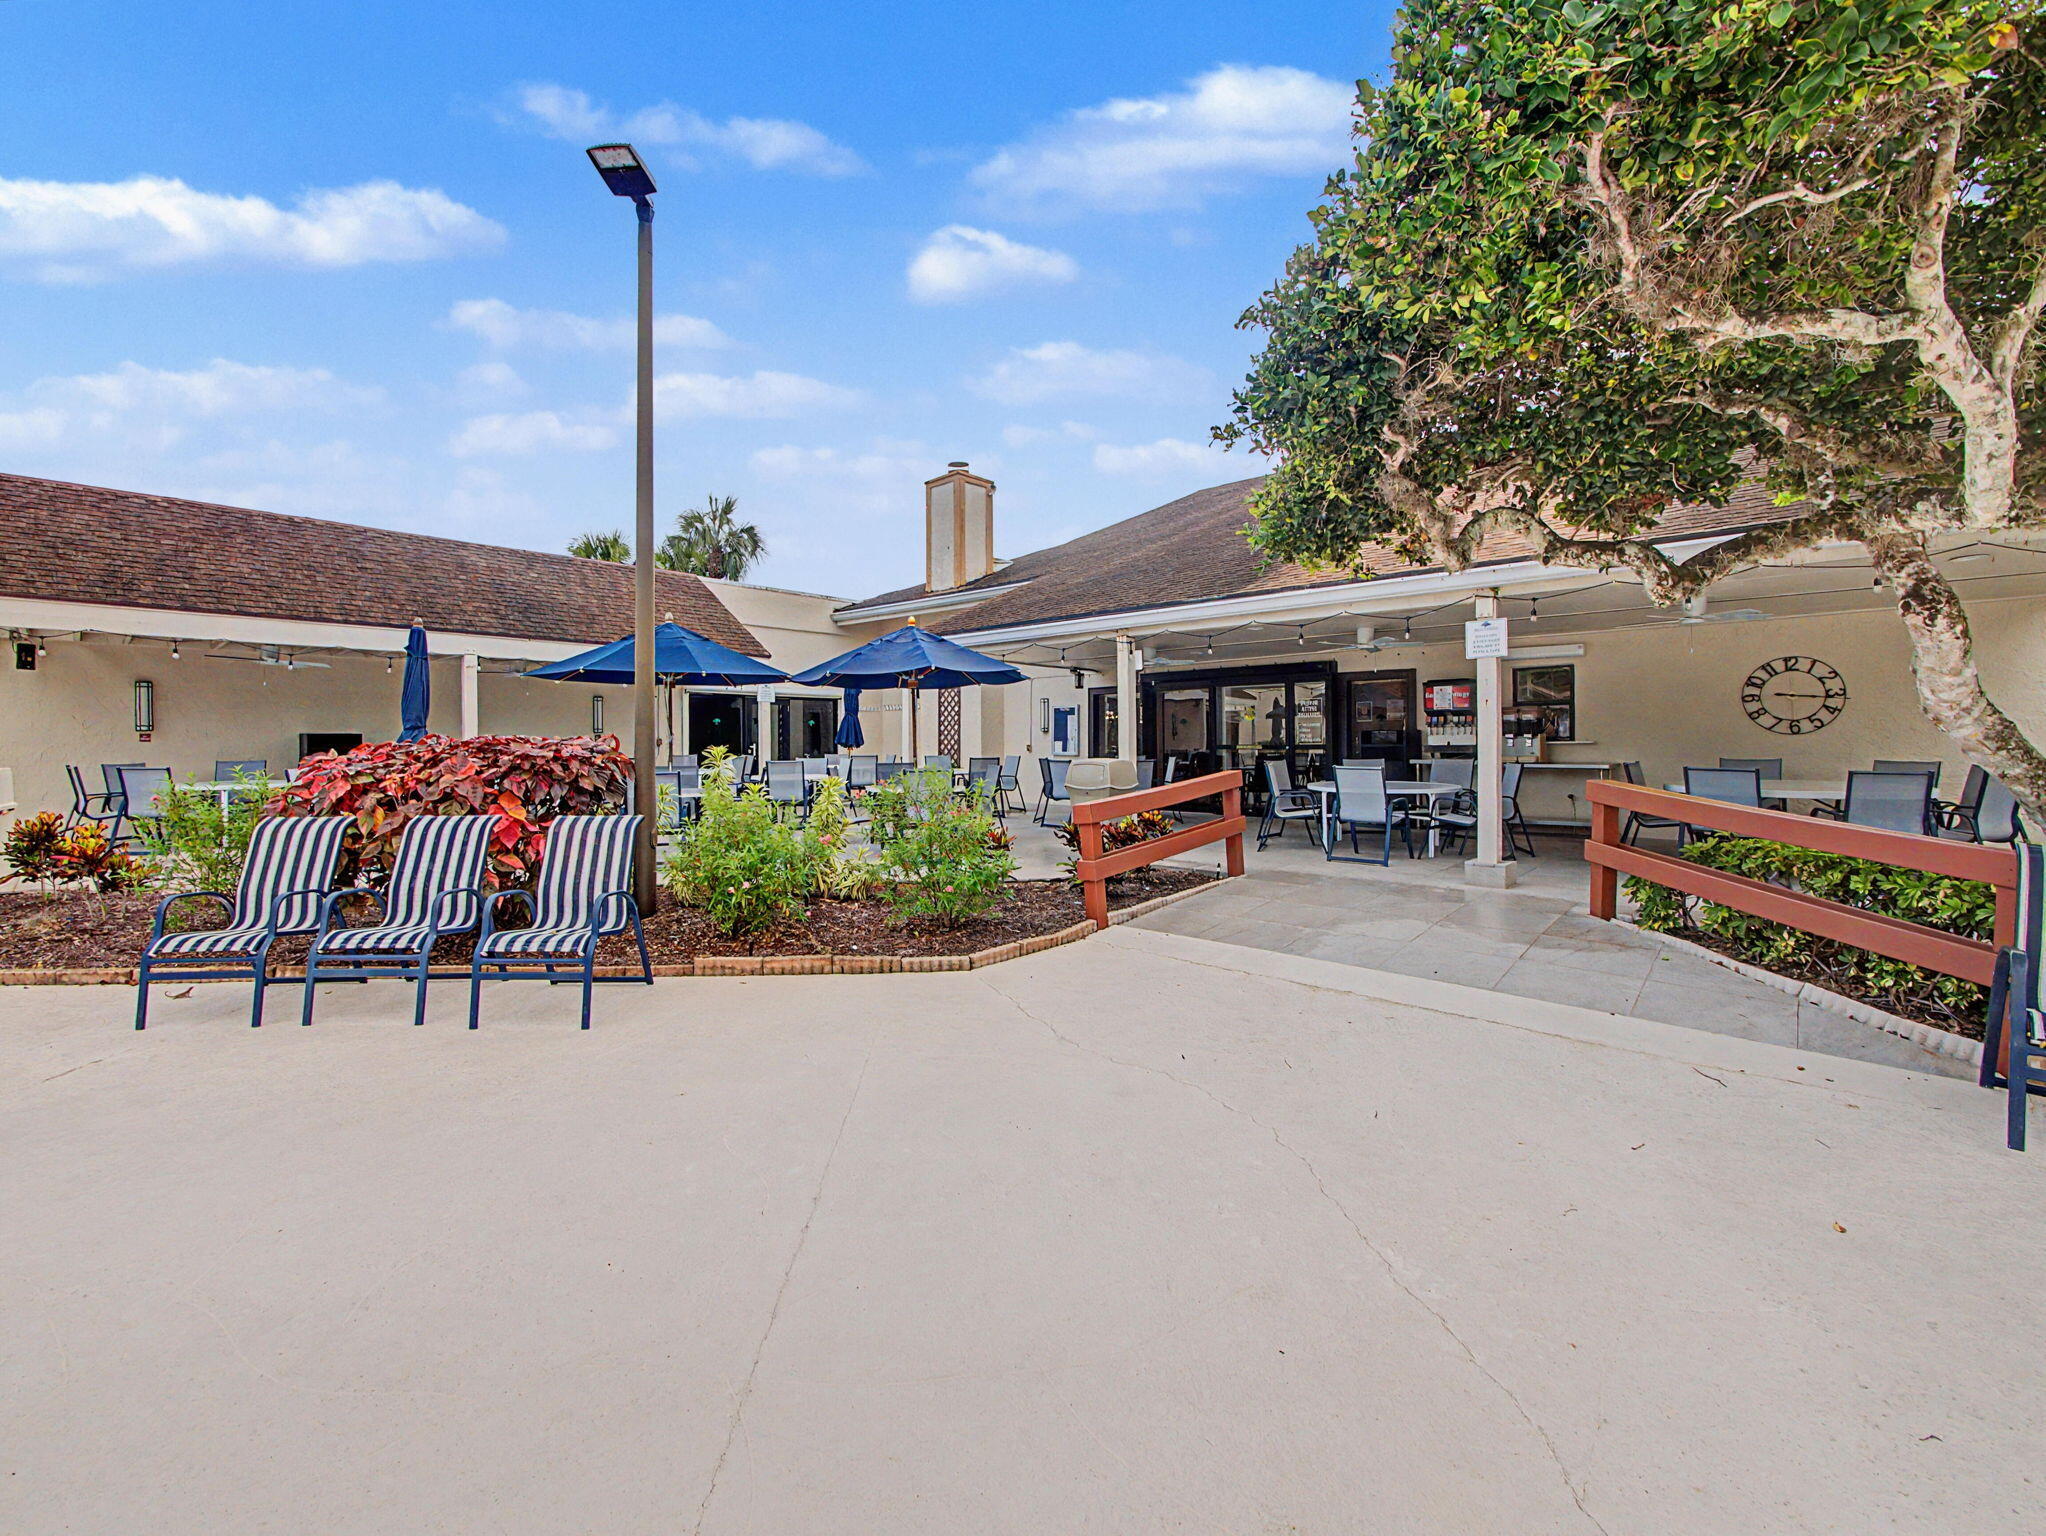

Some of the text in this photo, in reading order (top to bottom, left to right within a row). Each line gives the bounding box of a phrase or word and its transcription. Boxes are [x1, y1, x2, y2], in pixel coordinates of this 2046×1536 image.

[1761, 663, 1779, 677] 11
[1783, 657, 1799, 671] 12
[1807, 660, 1817, 674] 1
[1747, 676, 1765, 688] 10
[1819, 670, 1838, 685] 2
[1742, 694, 1760, 703] 9
[1826, 688, 1845, 698] 3
[1748, 707, 1767, 720] 8
[1823, 704, 1841, 715] 4
[1768, 716, 1782, 730] 7
[1789, 720, 1801, 734] 6
[1808, 713, 1824, 729] 5
